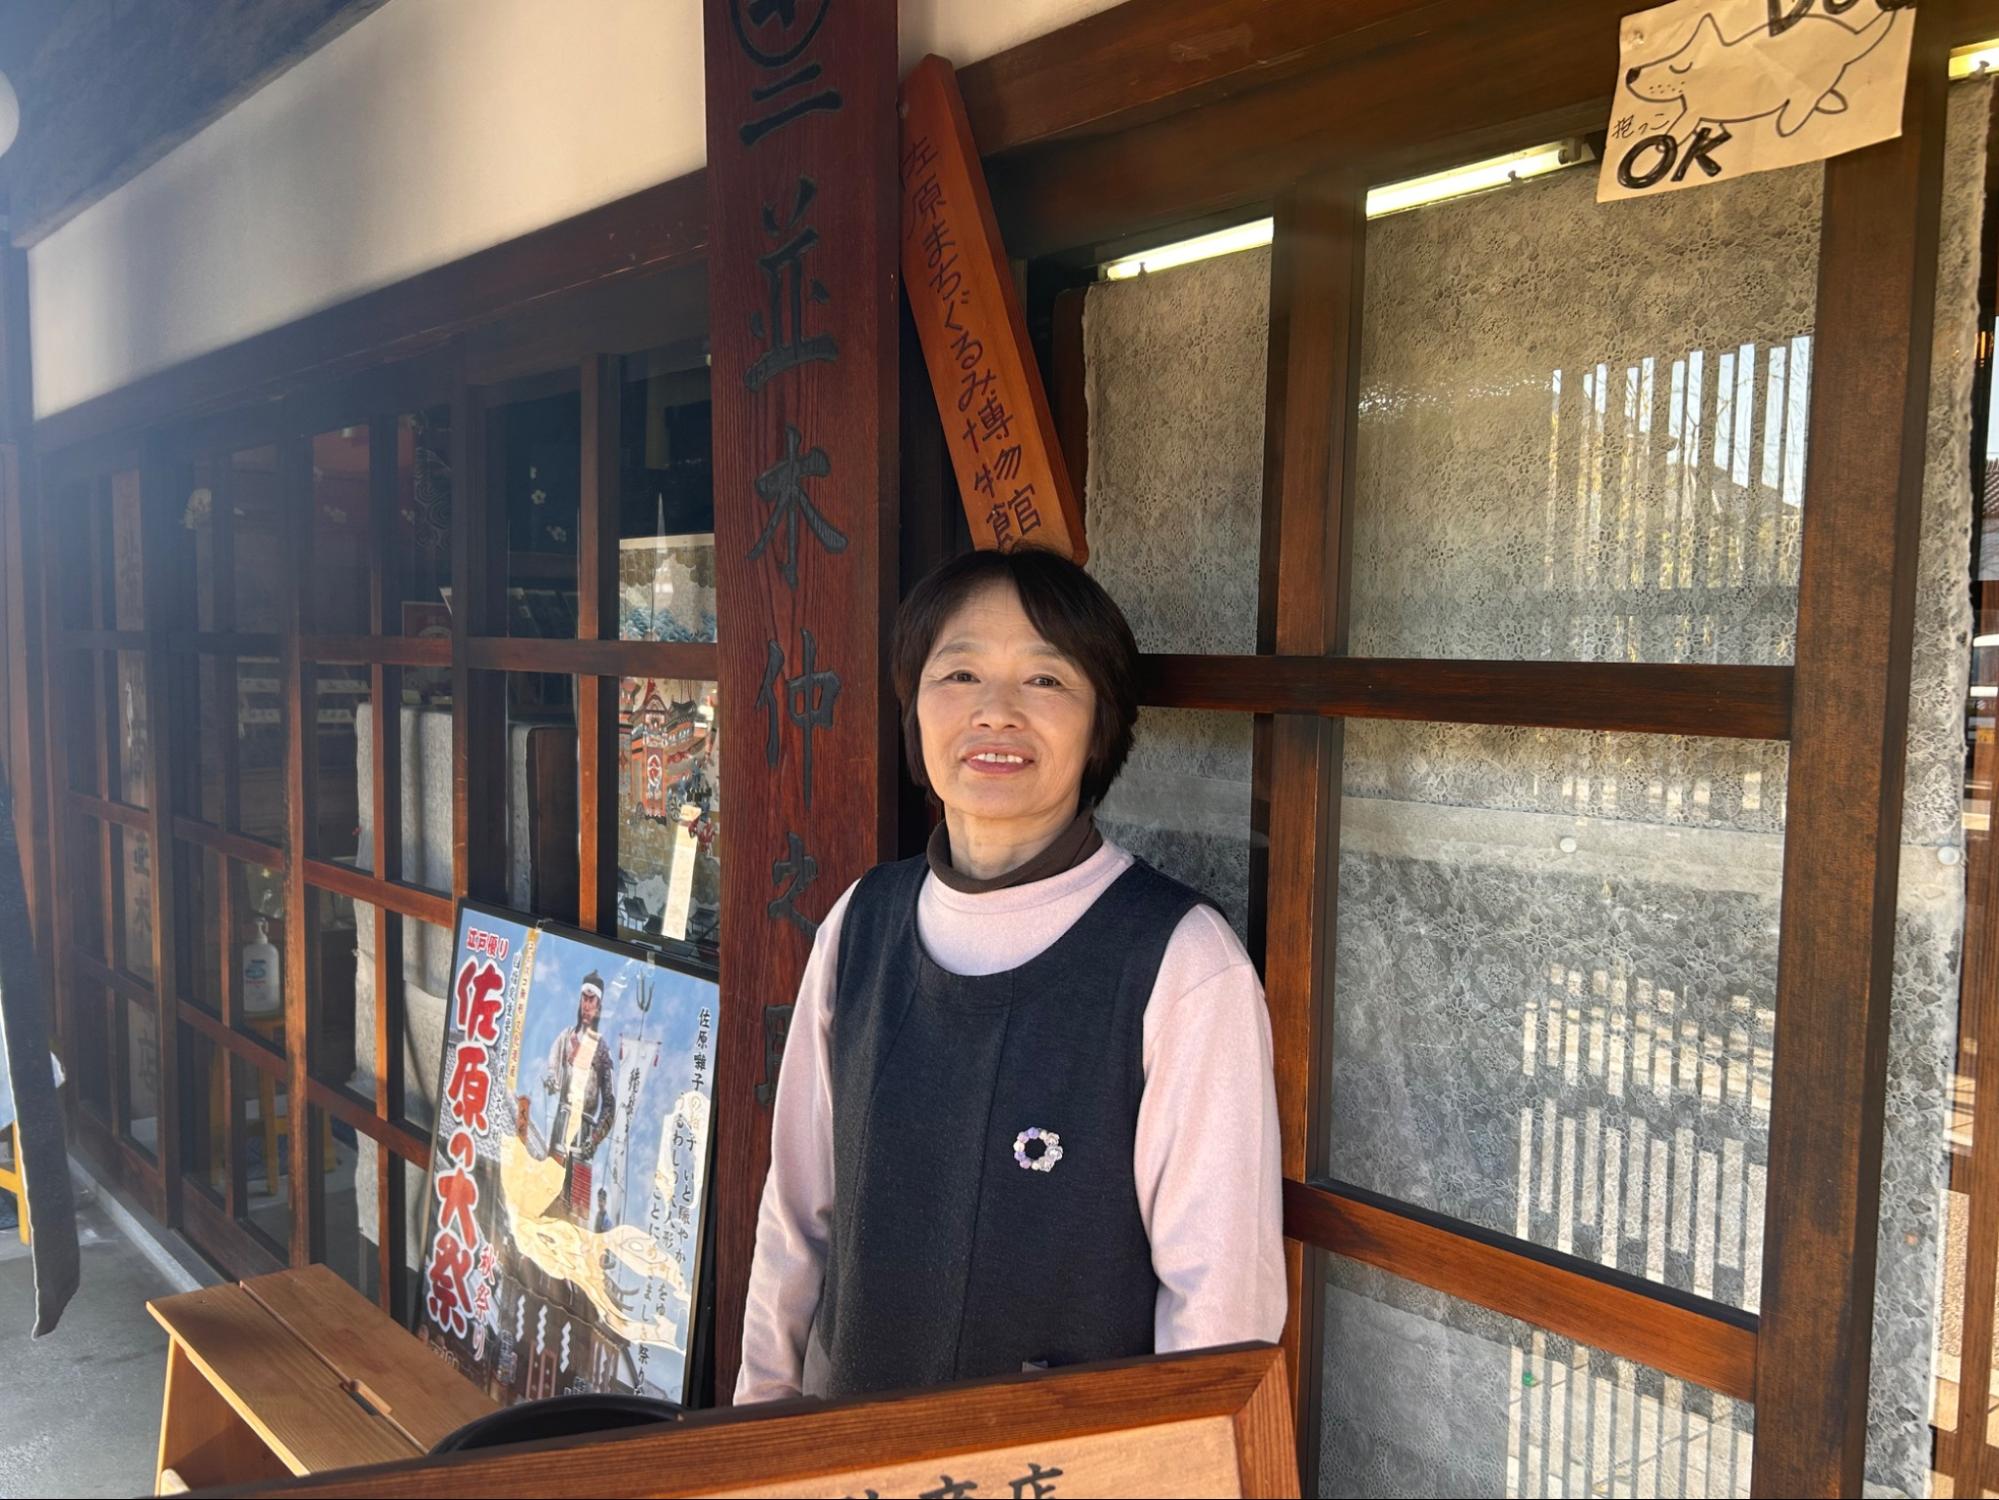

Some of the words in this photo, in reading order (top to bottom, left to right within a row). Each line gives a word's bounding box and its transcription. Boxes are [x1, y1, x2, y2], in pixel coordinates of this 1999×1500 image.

[1617, 126, 1733, 189] OK
[466, 926, 510, 961] 江戸優り
[427, 957, 506, 1341] 佐原の大祭
[472, 1242, 498, 1363] 秋祭り
